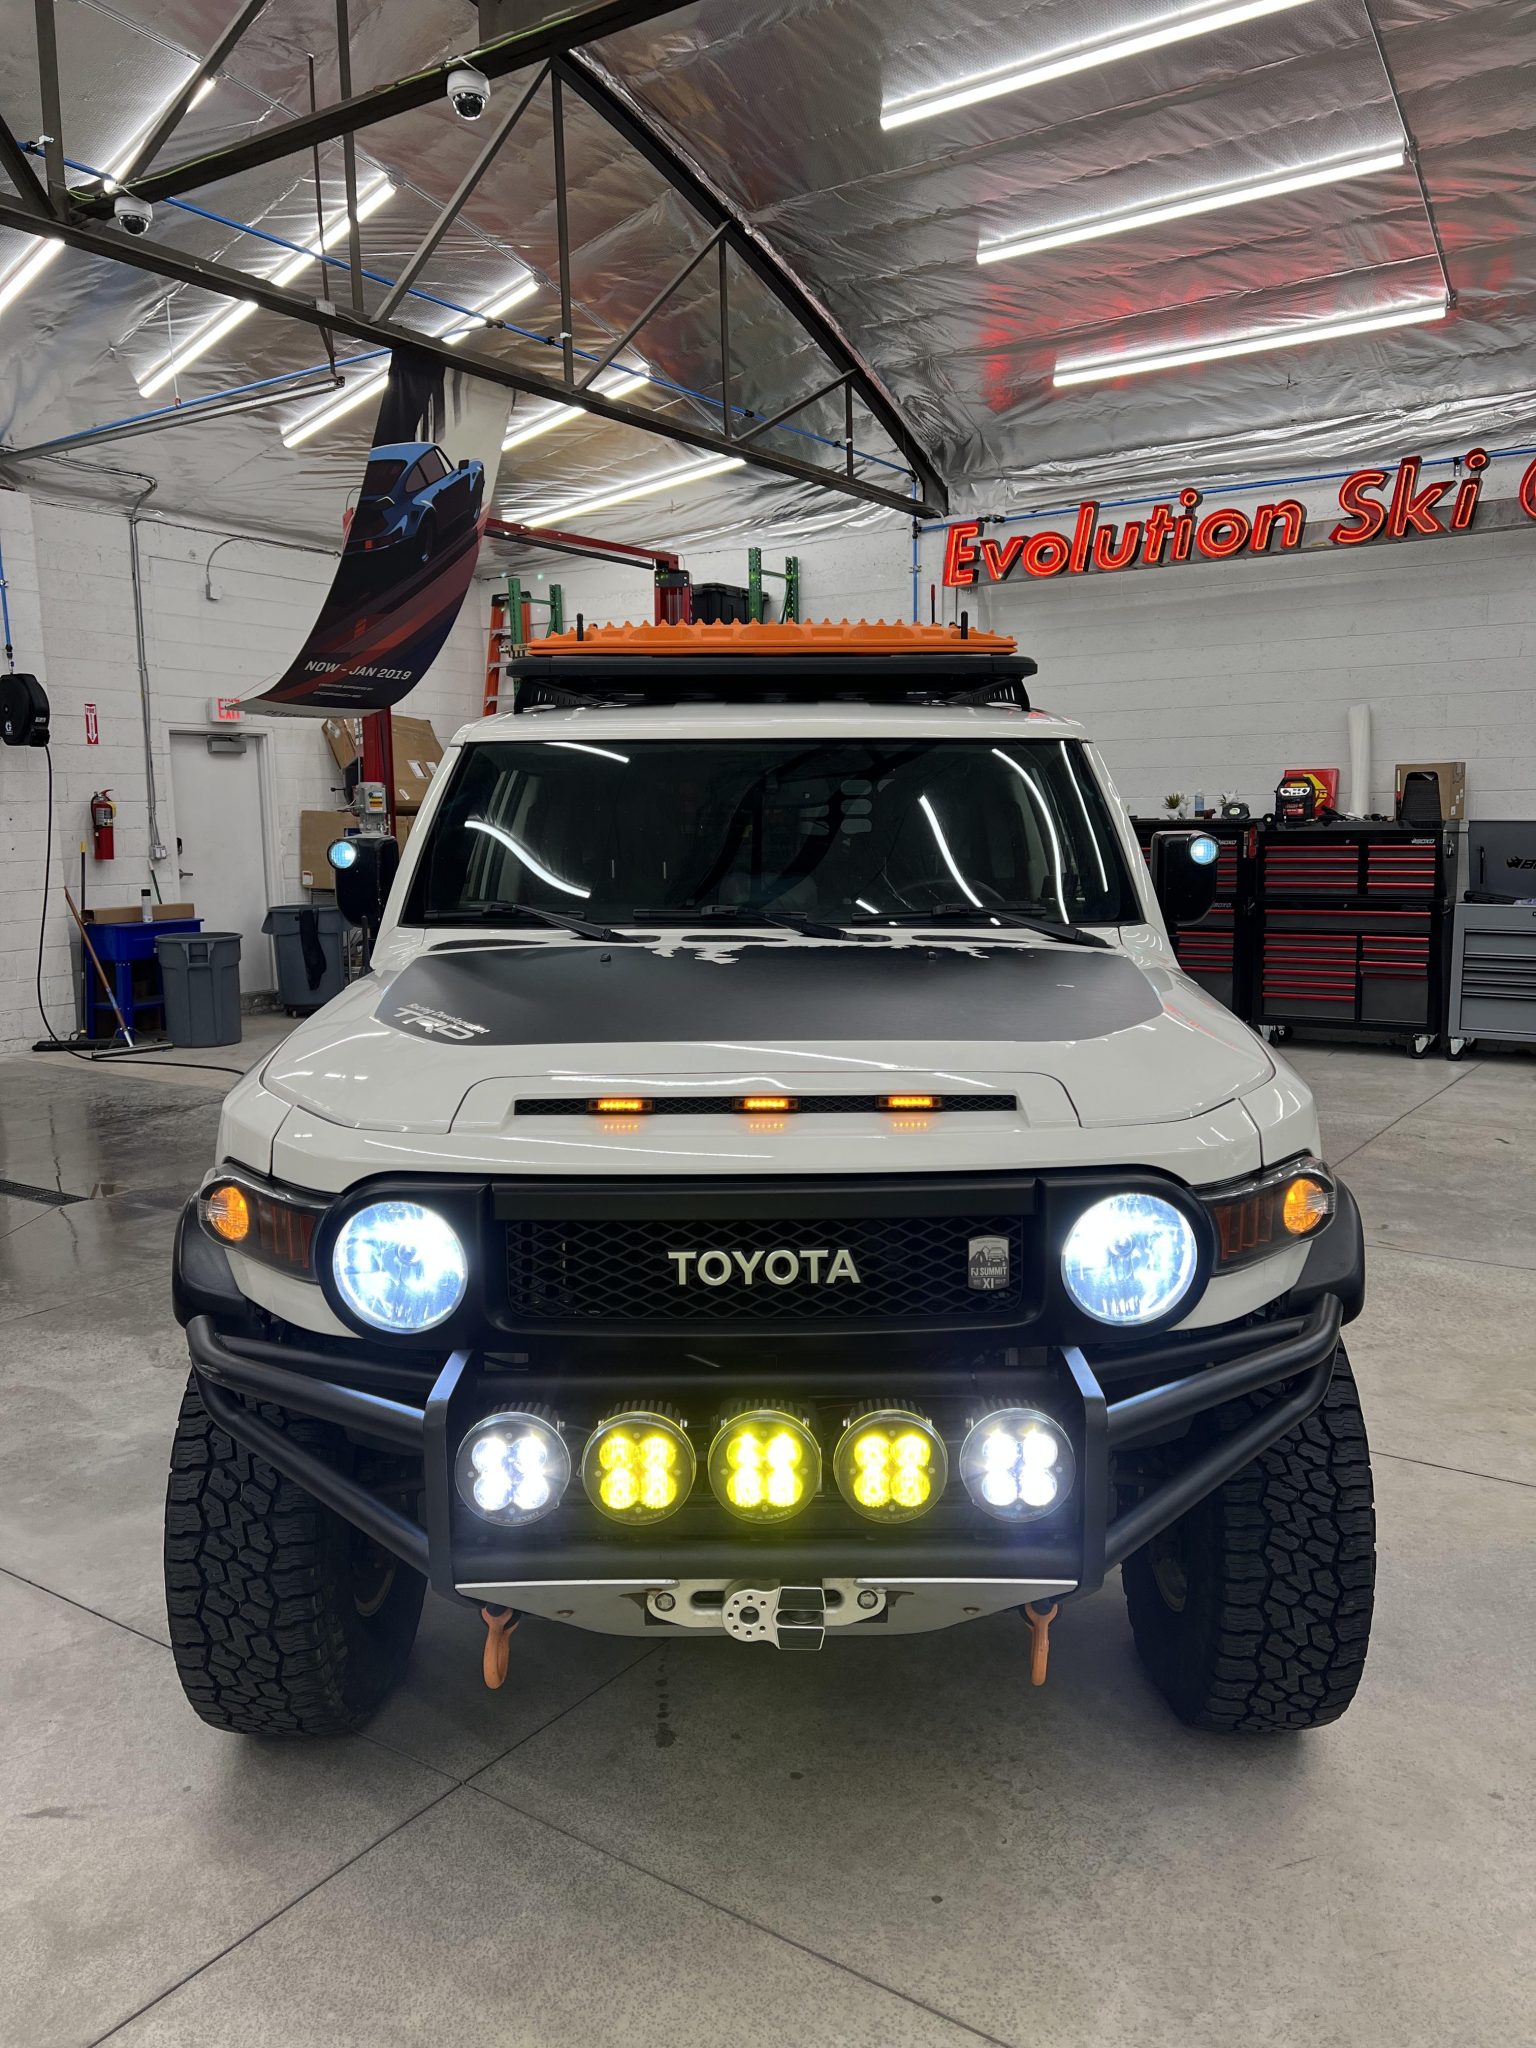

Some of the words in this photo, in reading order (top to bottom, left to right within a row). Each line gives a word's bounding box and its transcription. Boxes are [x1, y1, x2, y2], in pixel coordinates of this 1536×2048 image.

[943, 487, 1306, 587] Evolution
[1328, 448, 1490, 545] Ski
[304, 660, 340, 673] NOW
[349, 665, 377, 678] JAN
[376, 668, 412, 680] 2019
[393, 1007, 475, 1039] TRD
[668, 1250, 861, 1286] TOYOTA
[970, 1267, 979, 1276] FJ
[979, 1266, 1008, 1276] SUMMIT
[982, 1277, 995, 1289] XI
